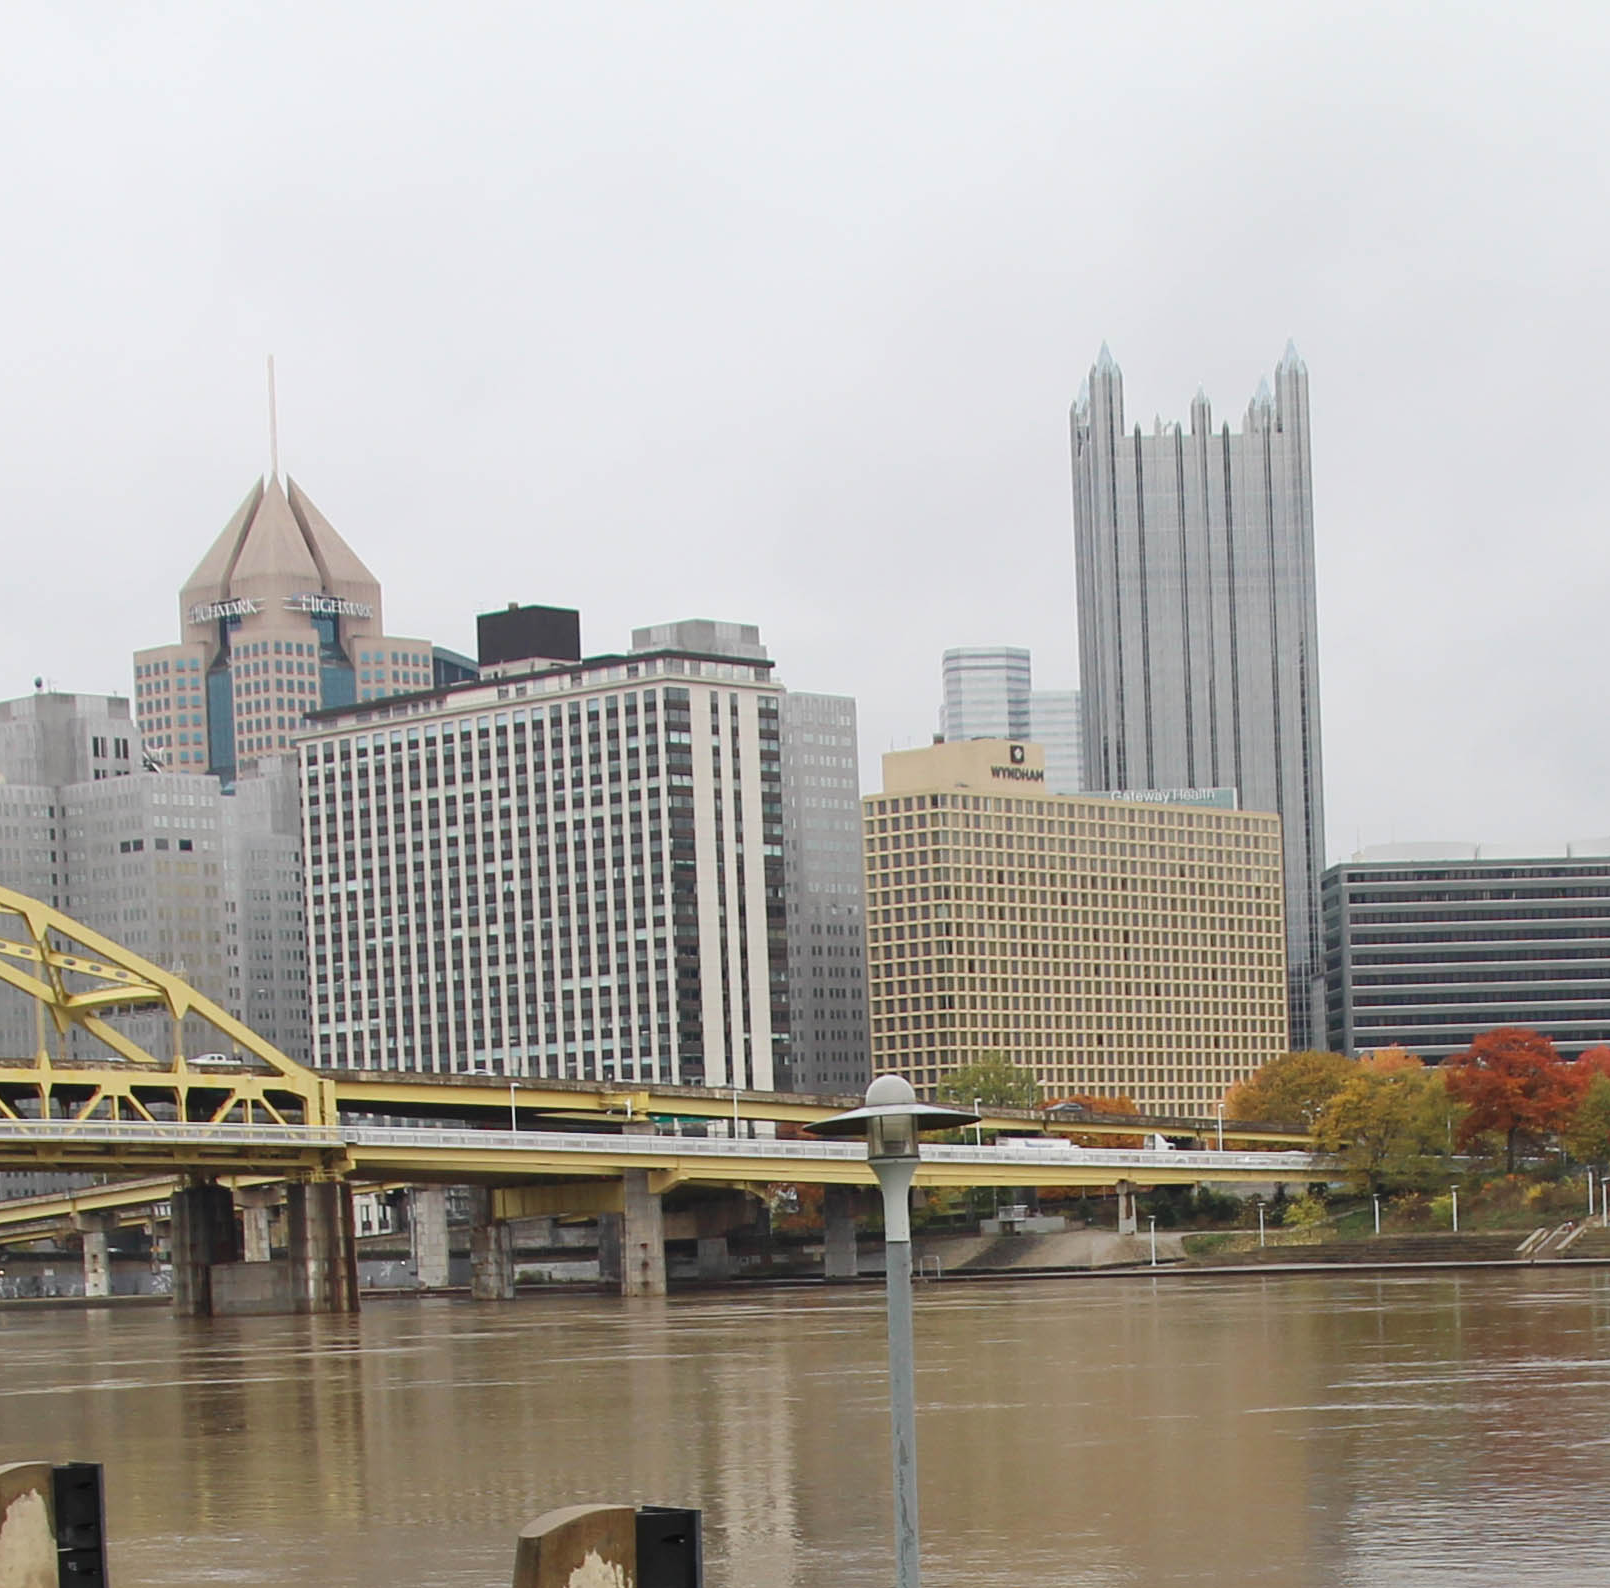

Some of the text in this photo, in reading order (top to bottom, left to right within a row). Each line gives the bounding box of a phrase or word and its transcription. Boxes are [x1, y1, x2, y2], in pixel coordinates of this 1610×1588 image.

[990, 765, 1045, 783] WYNDHAM
[1111, 787, 1215, 804] Gateway Health
